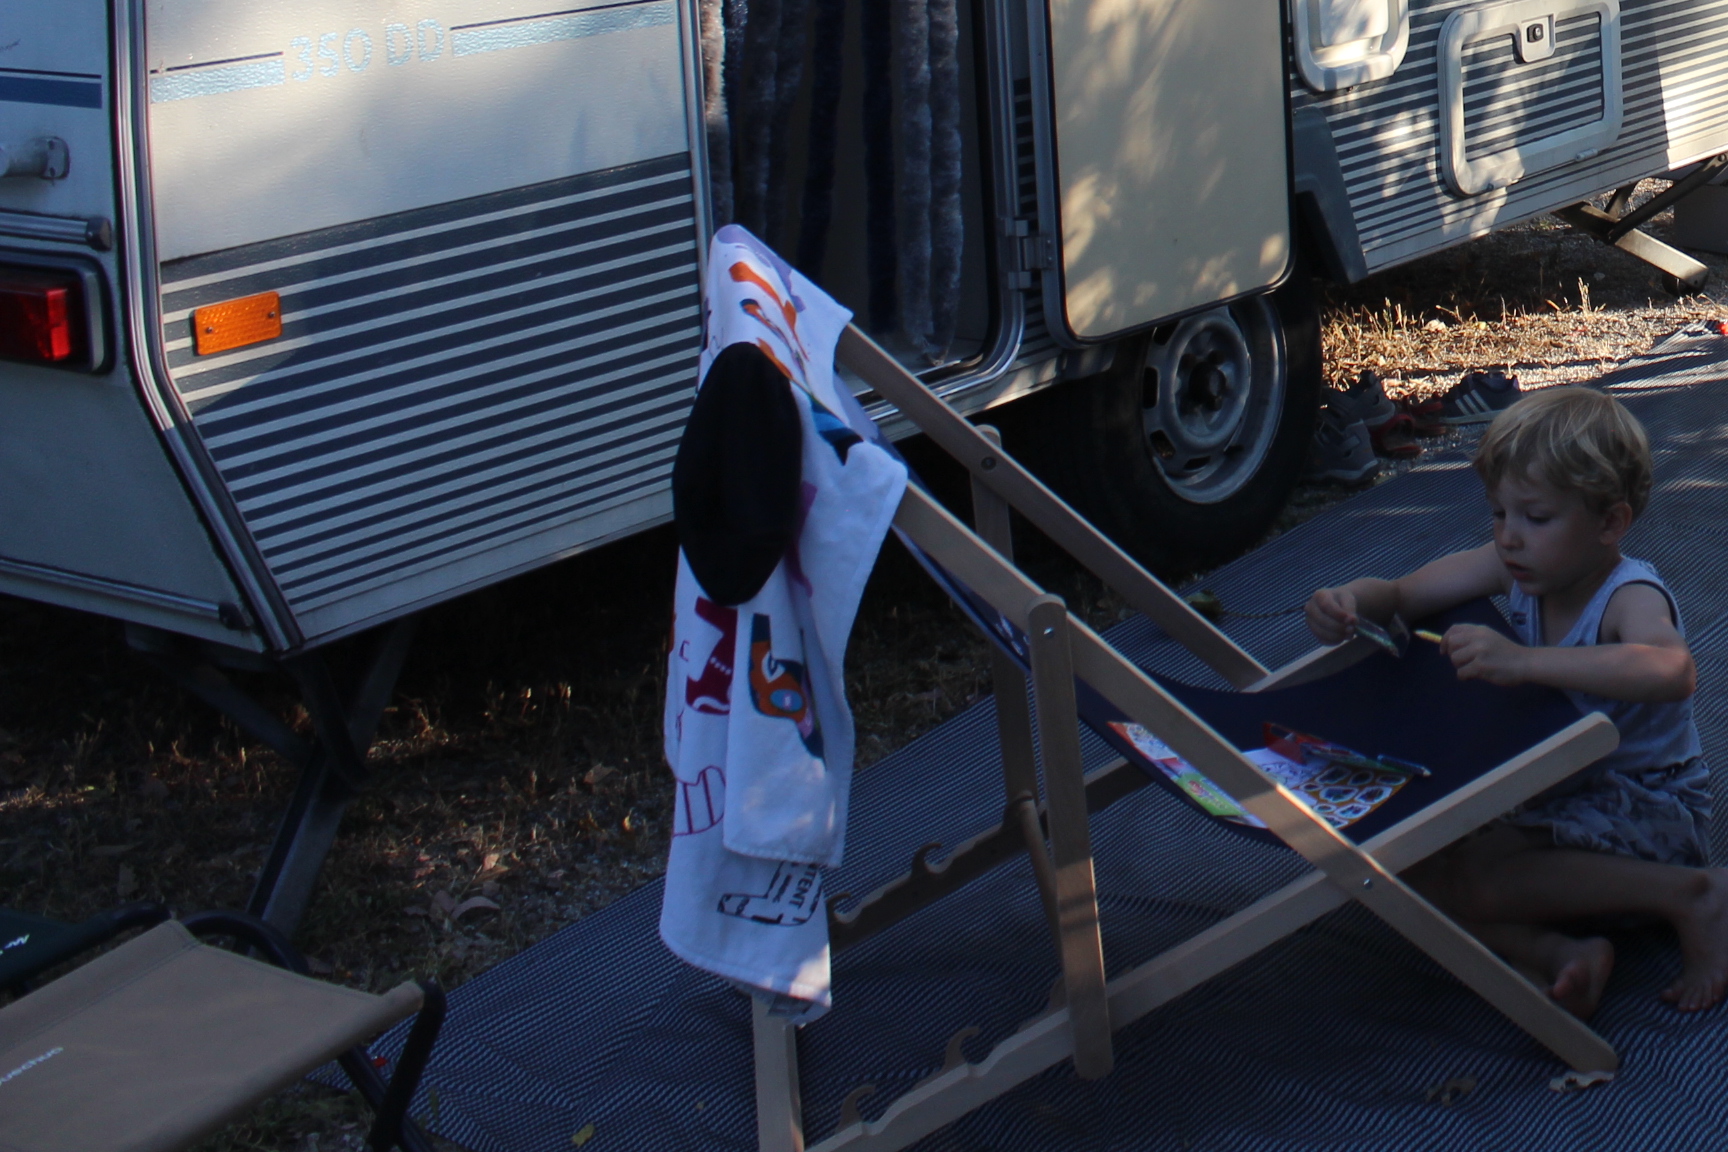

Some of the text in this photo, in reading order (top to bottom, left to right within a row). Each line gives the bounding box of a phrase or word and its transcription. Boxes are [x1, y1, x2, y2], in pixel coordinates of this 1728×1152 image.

[290, 18, 445, 83] 350 DD
[0, 1045, 65, 1087] uechua
